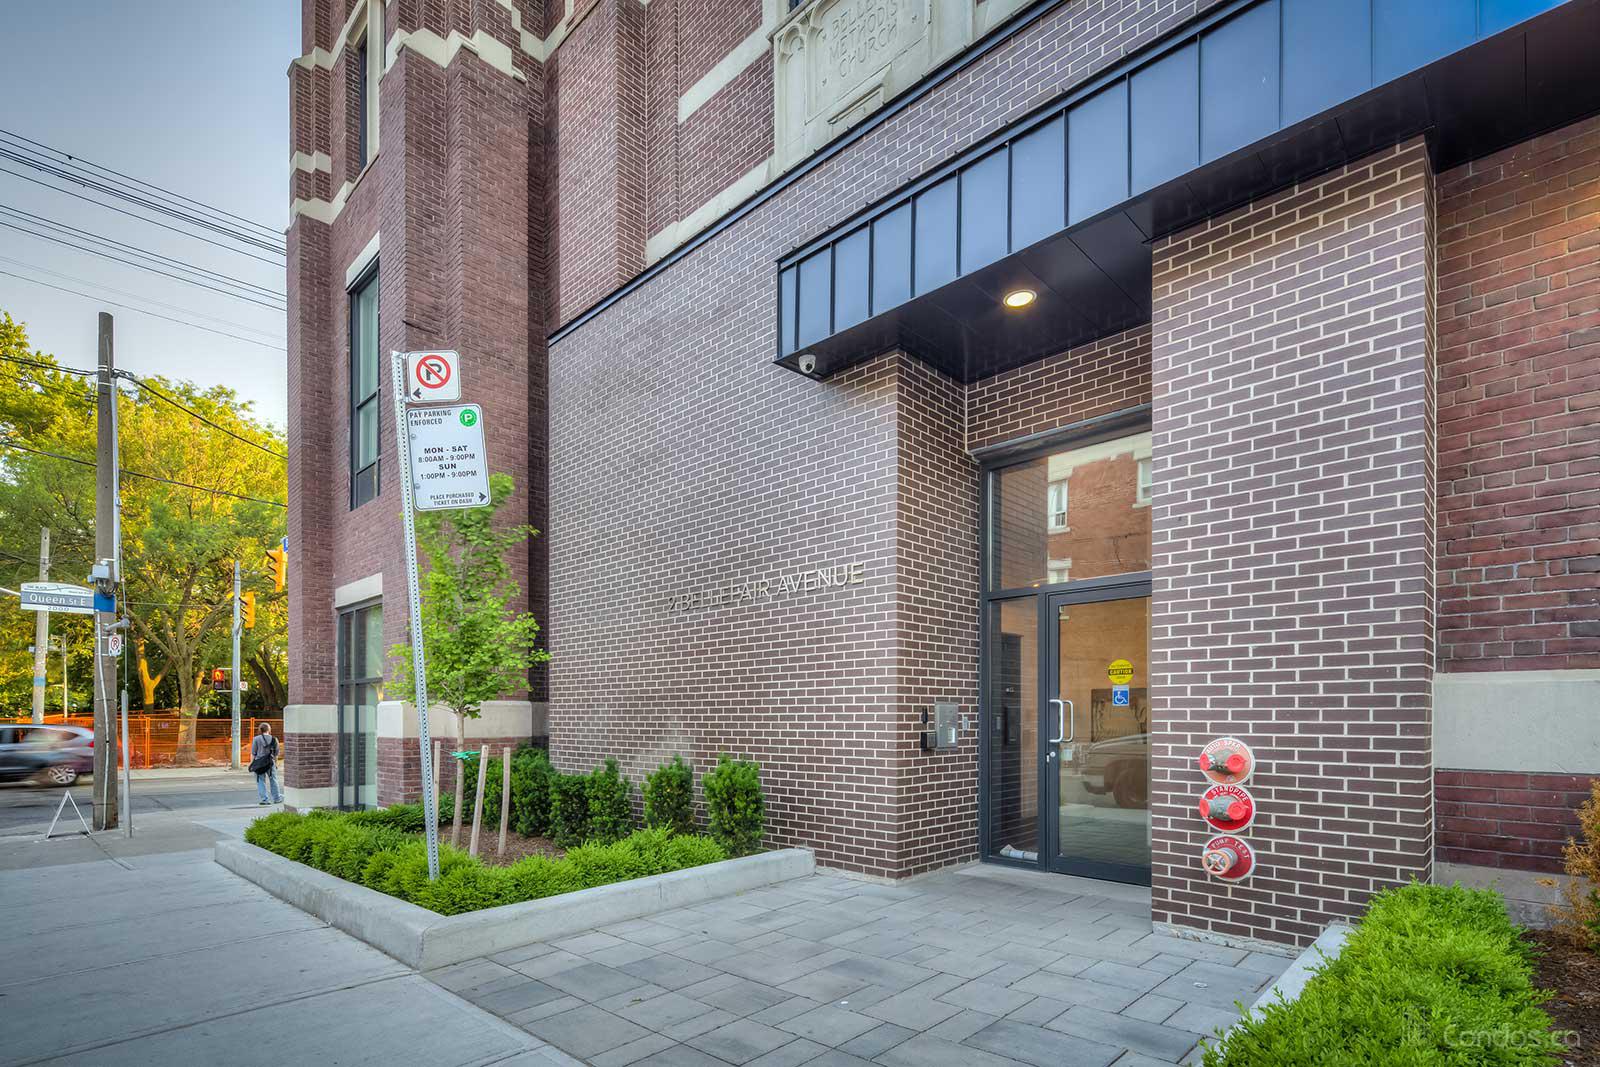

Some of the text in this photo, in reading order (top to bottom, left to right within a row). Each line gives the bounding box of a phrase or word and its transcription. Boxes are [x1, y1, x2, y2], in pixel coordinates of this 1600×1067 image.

[840, 18, 897, 77] CHURCH
[409, 409, 452, 419] PAY PARKING
[410, 418, 442, 426] ENFORCED
[424, 446, 443, 454] MON
[452, 445, 468, 453] SAT
[418, 455, 444, 463] 8:00AM
[450, 453, 476, 461] 9:00PM
[420, 472, 446, 480] 1:00PM
[451, 470, 477, 478] 9:00PM
[680, 580, 771, 612] BELLEFAIR
[777, 561, 865, 596] AVENUE
[29, 593, 66, 605] Queen
[80, 597, 87, 606] E
[1210, 785, 1249, 802] STANDPIPE
